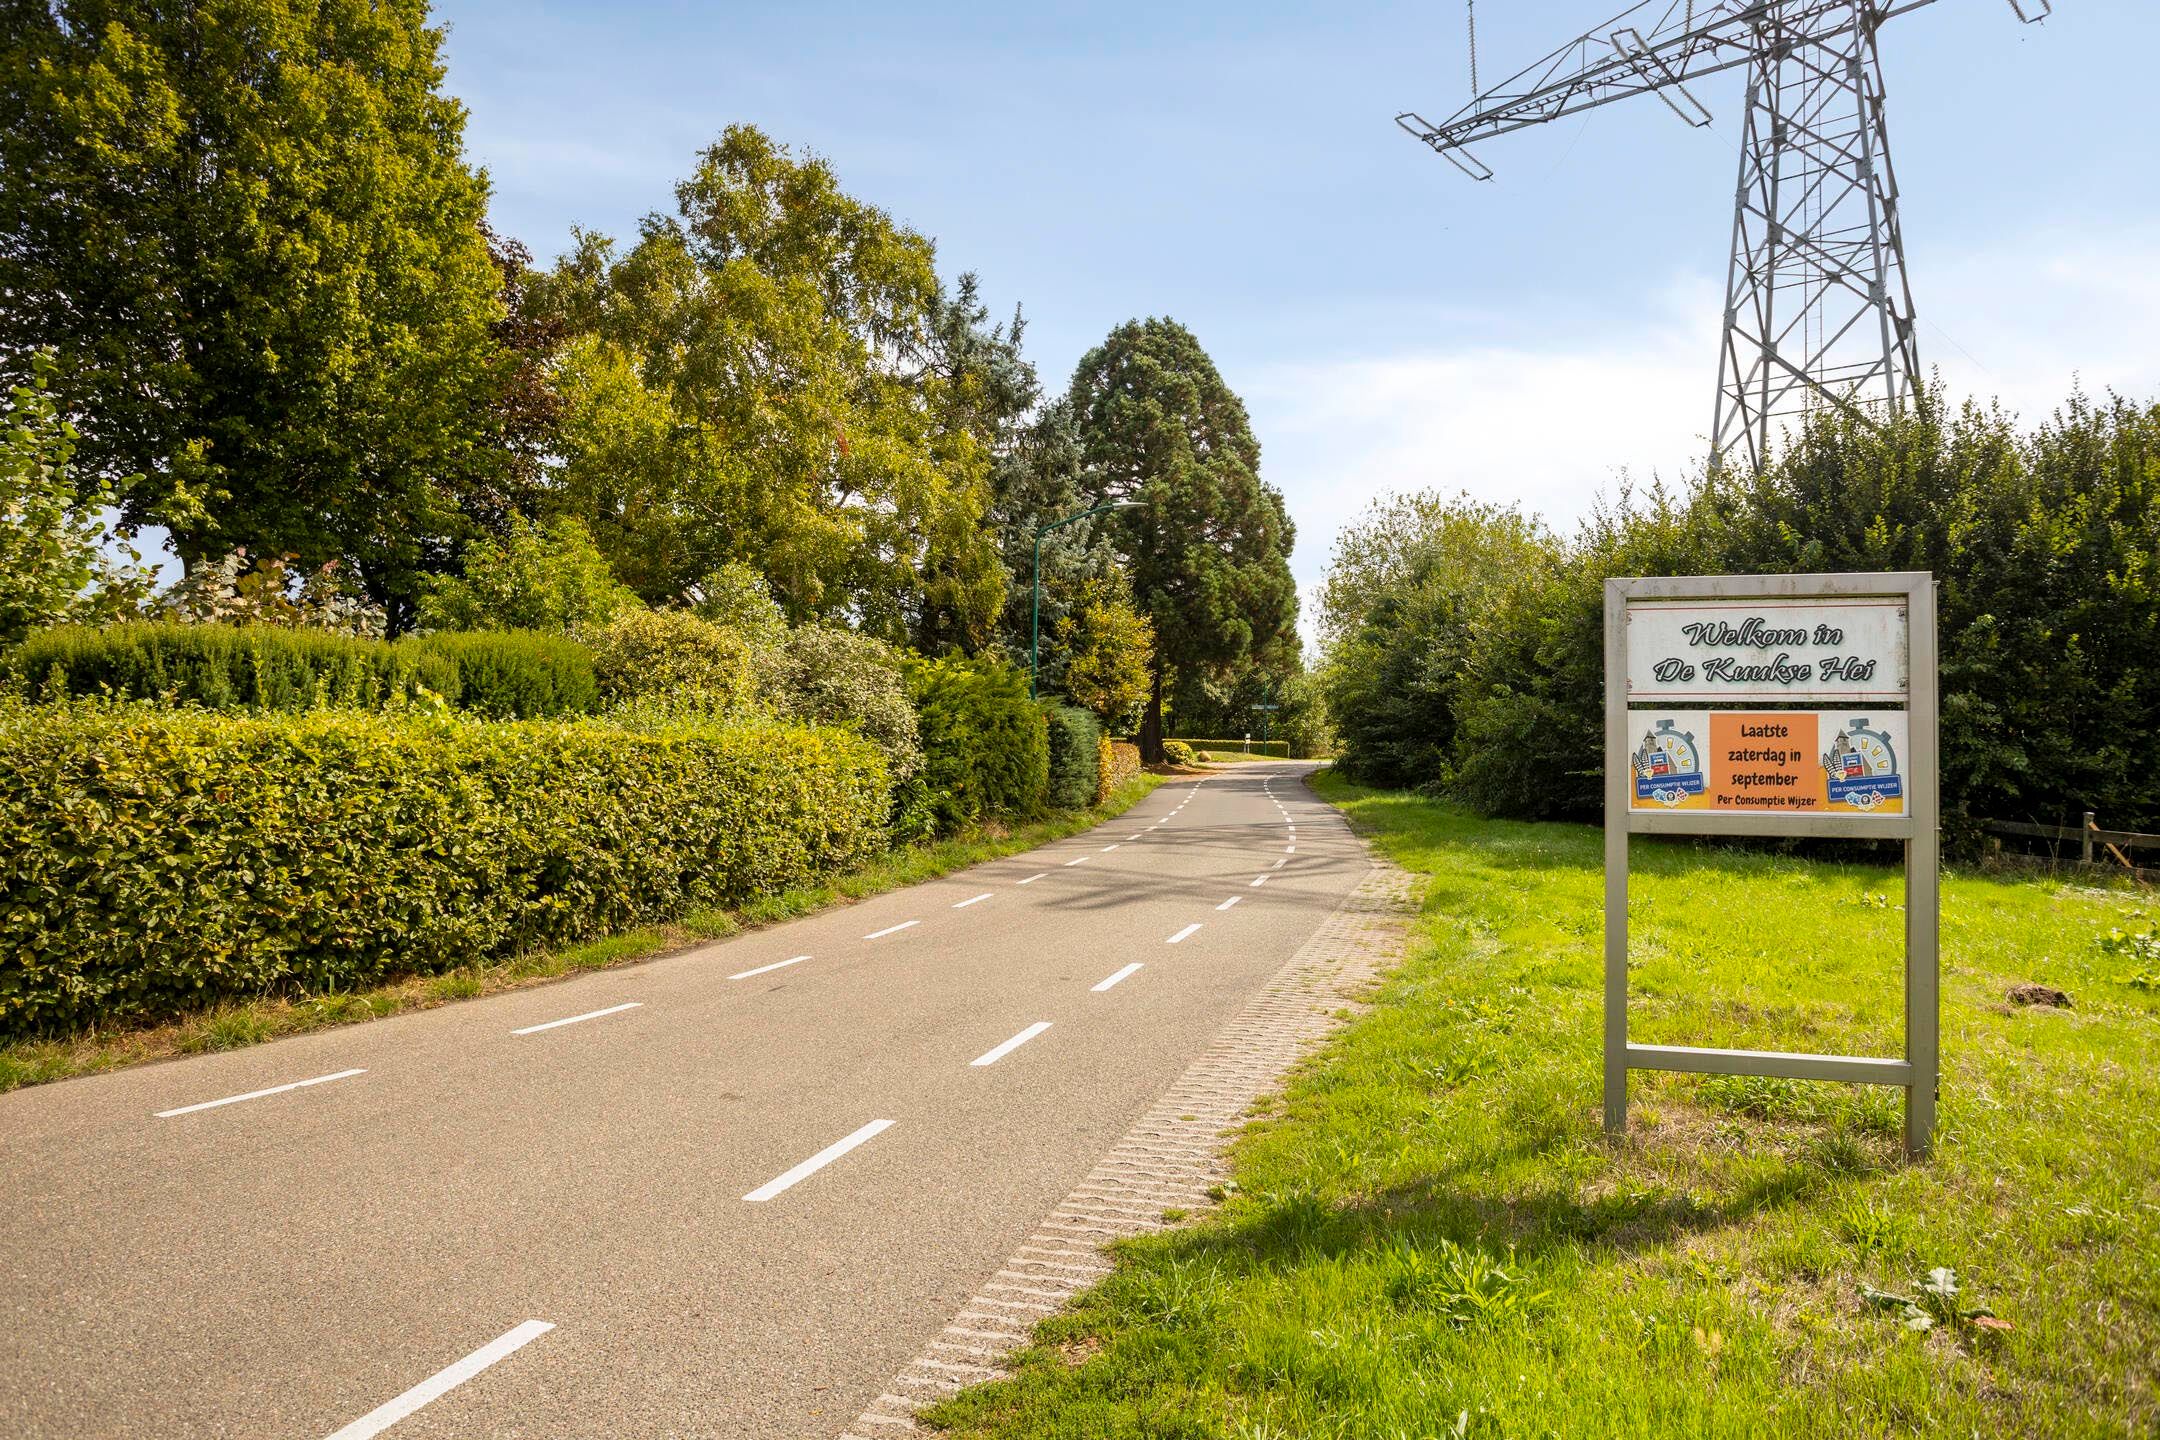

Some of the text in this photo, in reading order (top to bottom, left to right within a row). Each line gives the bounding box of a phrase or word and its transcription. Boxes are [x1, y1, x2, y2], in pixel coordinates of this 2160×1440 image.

[1682, 617, 1844, 648] Welkom in
[1653, 653, 1877, 685] De Kuukse Hei
[1741, 724, 1788, 737] Laatste
[1728, 748, 1801, 766] zaterdag in
[1731, 772, 1798, 789] september
[1717, 794, 1816, 808] Per Consumptie Wijzer
